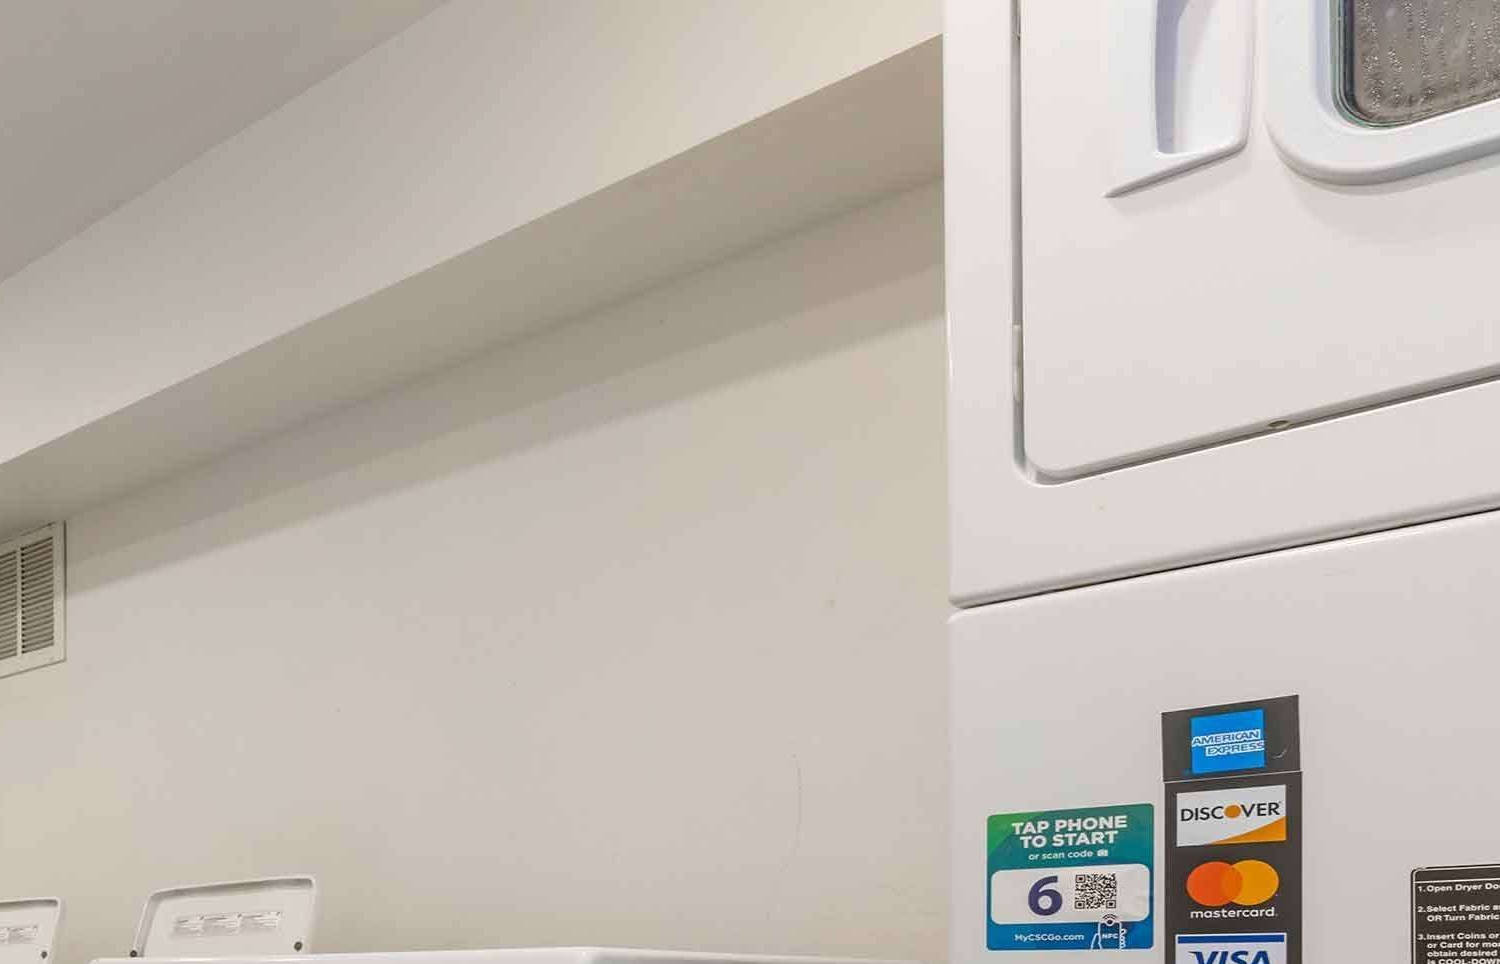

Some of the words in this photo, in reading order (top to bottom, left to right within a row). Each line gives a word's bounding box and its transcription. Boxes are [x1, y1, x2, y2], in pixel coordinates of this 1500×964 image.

[1192, 730, 1260, 747] AMERICAN
[1207, 740, 1264, 755] EXPRESS
[1180, 802, 1280, 822] DISCOVER
[1012, 820, 1049, 835] TAP
[1055, 815, 1128, 832] PHONE
[1020, 835, 1047, 848] TO
[1052, 830, 1118, 847] START
[1042, 851, 1065, 860] scan
[1067, 849, 1093, 858] code
[1455, 883, 1482, 892] Dryer
[1027, 876, 1063, 916] 6
[1190, 907, 1276, 920] mastercard
[1459, 904, 1490, 912] Fabric
[1445, 914, 1466, 922] Turn
[1468, 913, 1500, 921] Fabric
[1014, 933, 1085, 943] MyCSCGo.com
[1457, 932, 1486, 940] Coins
[1466, 941, 1480, 949] for
[1460, 949, 1498, 957] desired
